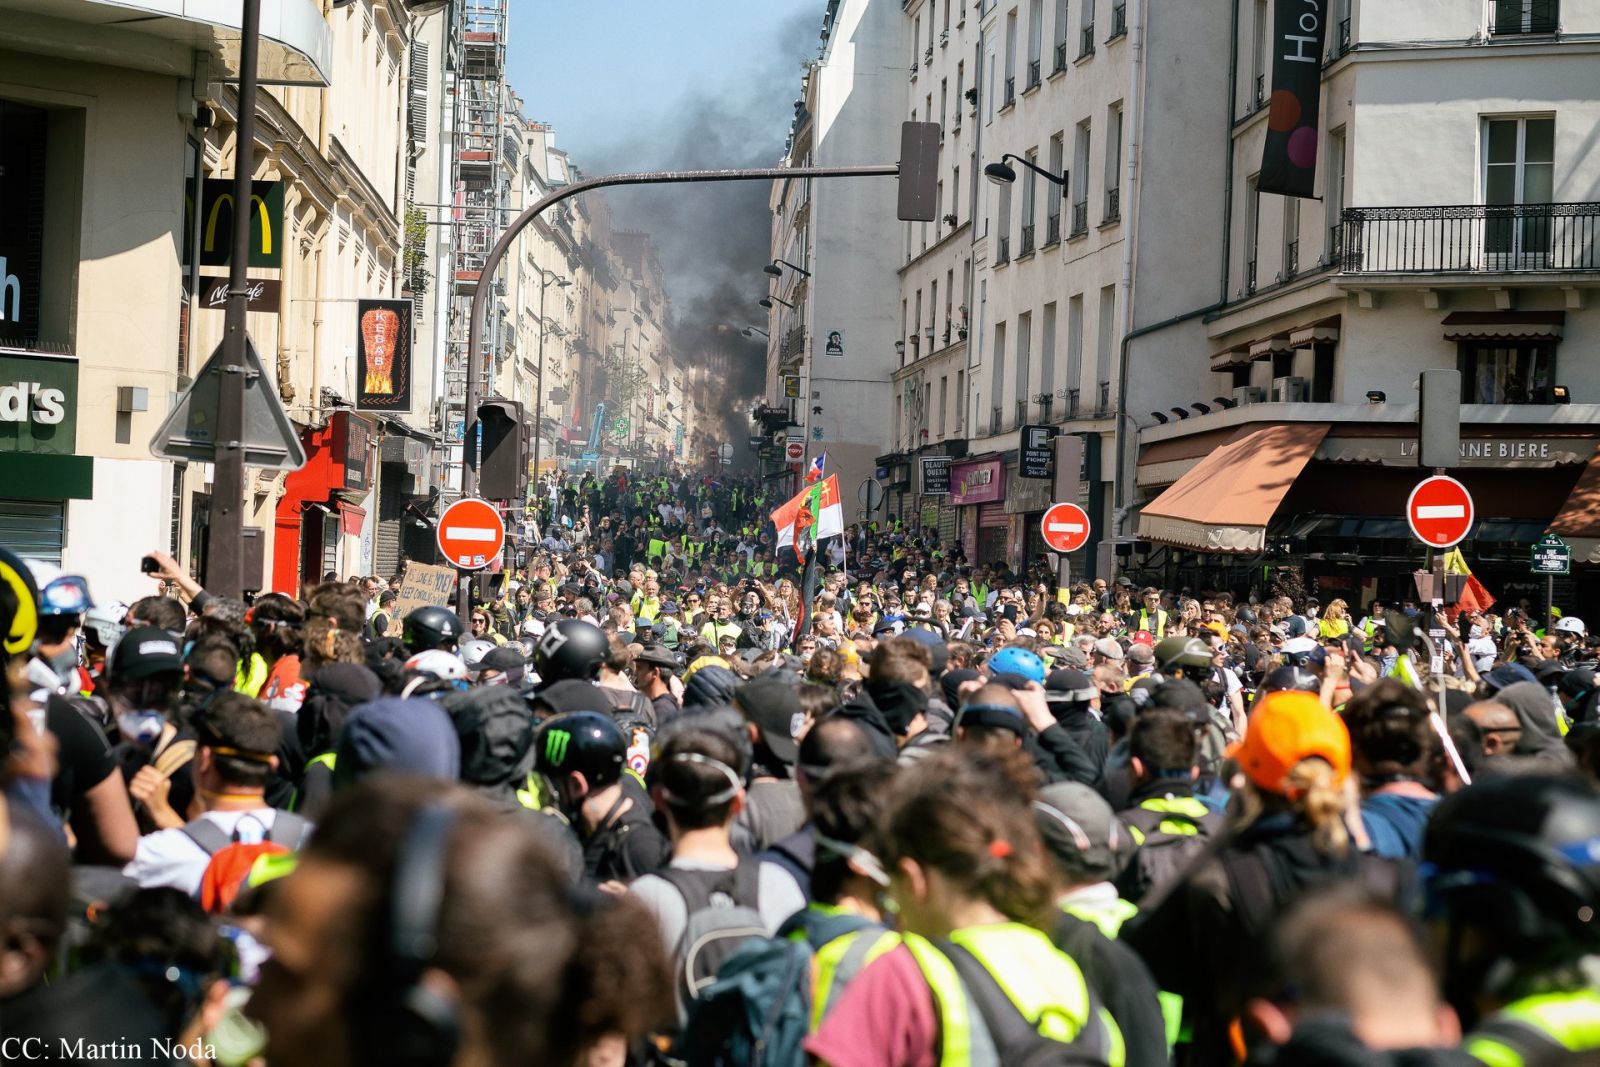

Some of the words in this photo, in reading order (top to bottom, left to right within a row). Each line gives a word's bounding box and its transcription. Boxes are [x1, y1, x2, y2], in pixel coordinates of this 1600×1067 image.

[374, 312, 386, 367] KEBAB
[0, 382, 65, 425] d's
[1499, 443, 1549, 458] BIERE
[926, 468, 947, 476] QUEEN
